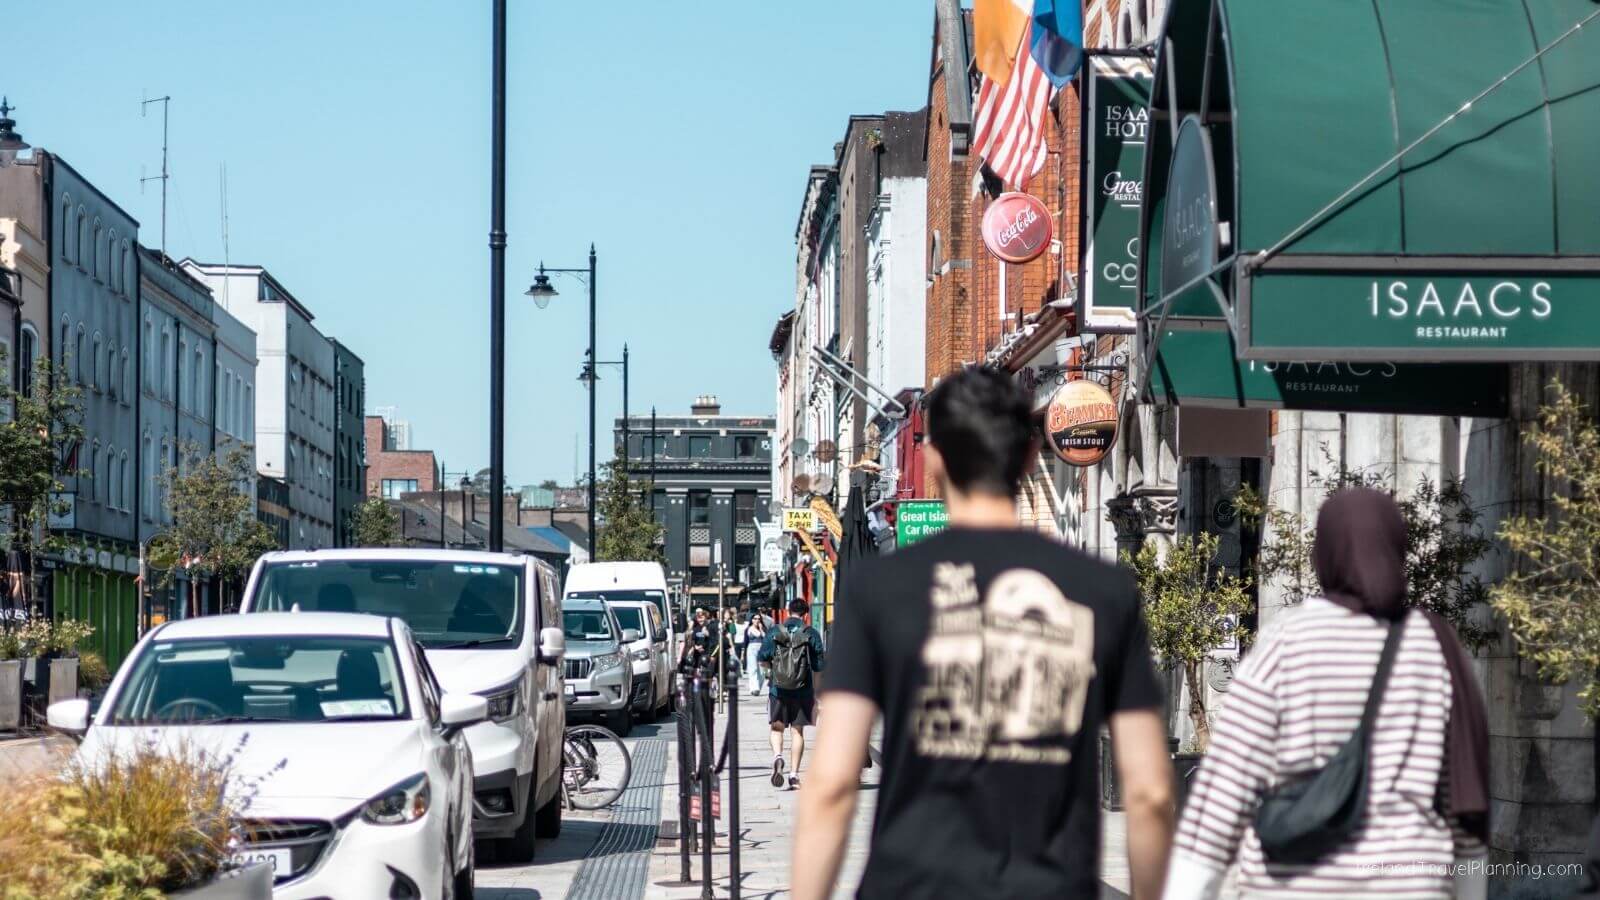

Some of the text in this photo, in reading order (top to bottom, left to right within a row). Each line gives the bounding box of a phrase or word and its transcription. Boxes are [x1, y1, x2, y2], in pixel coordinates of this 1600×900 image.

[1371, 281, 1553, 317] ISAACS
[1416, 326, 1509, 339] RESTAURANT
[1285, 382, 1362, 393] RESTAURANT
[1061, 438, 1105, 446] IRISH STOUT
[786, 511, 812, 520] TAXI
[900, 511, 926, 522] Great
[905, 524, 921, 535] Car
